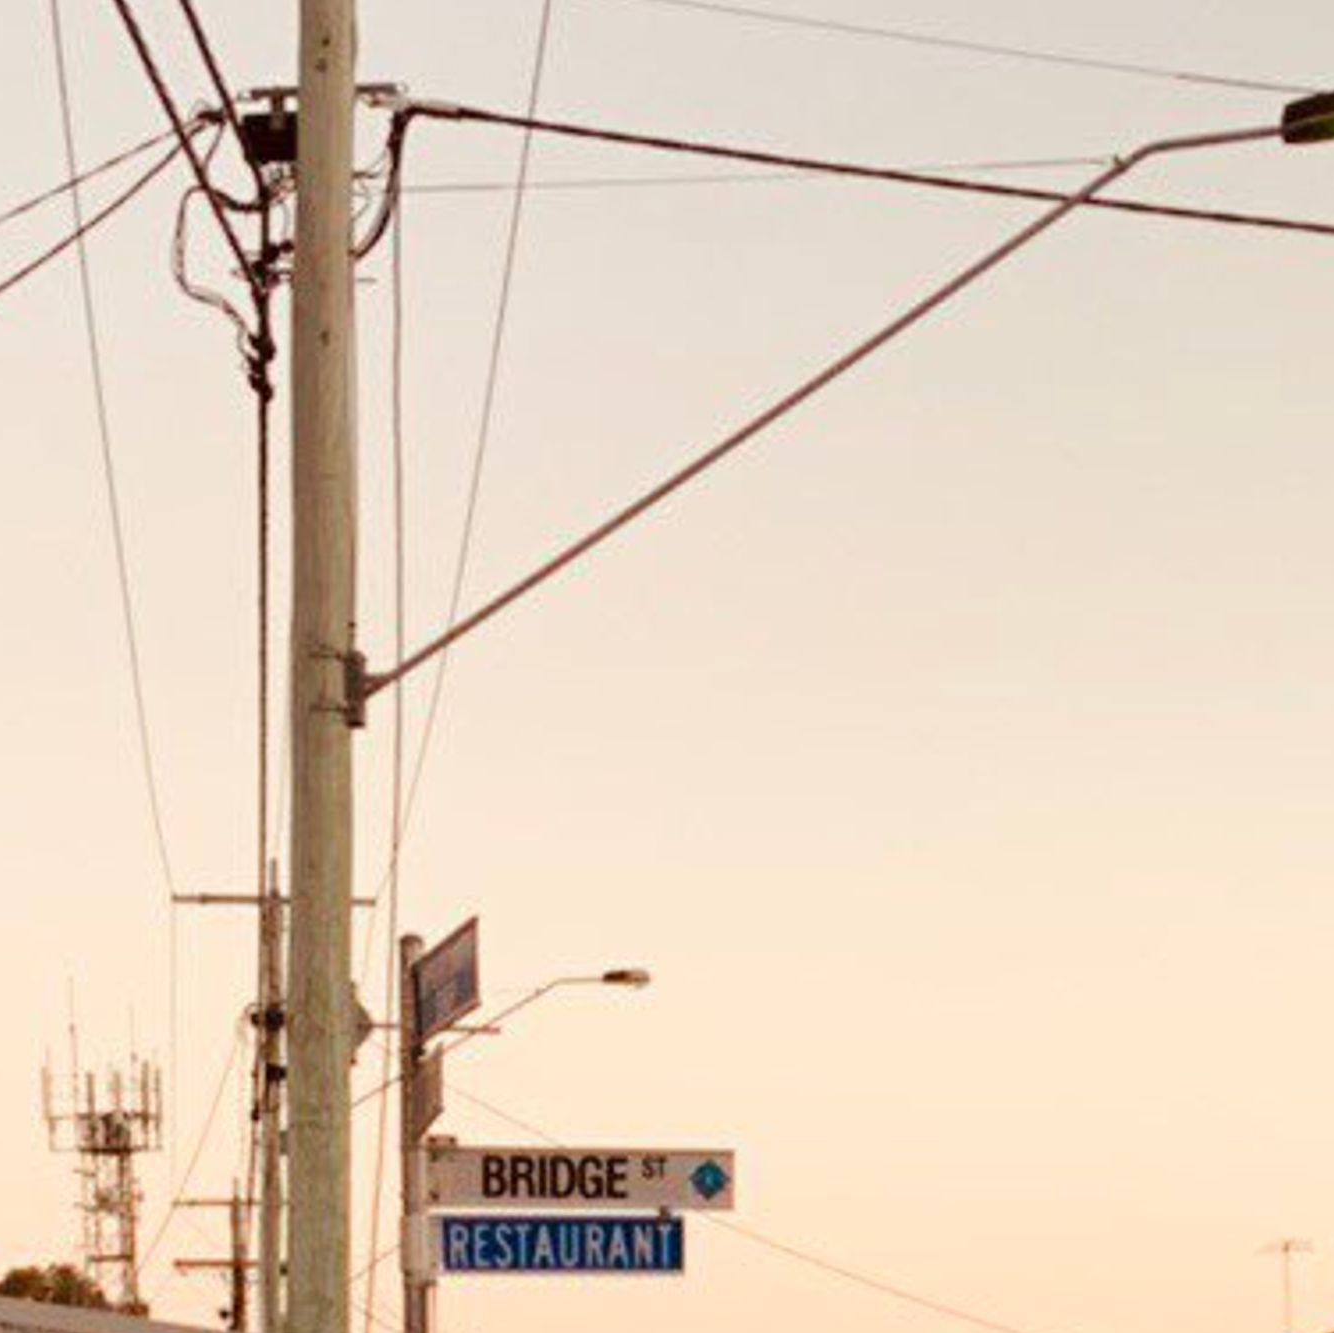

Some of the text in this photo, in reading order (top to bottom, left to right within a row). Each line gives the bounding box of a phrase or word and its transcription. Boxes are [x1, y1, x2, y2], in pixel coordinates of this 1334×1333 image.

[481, 1155, 668, 1199] BRIDGE ST
[449, 1223, 673, 1269] RESTAURANT
